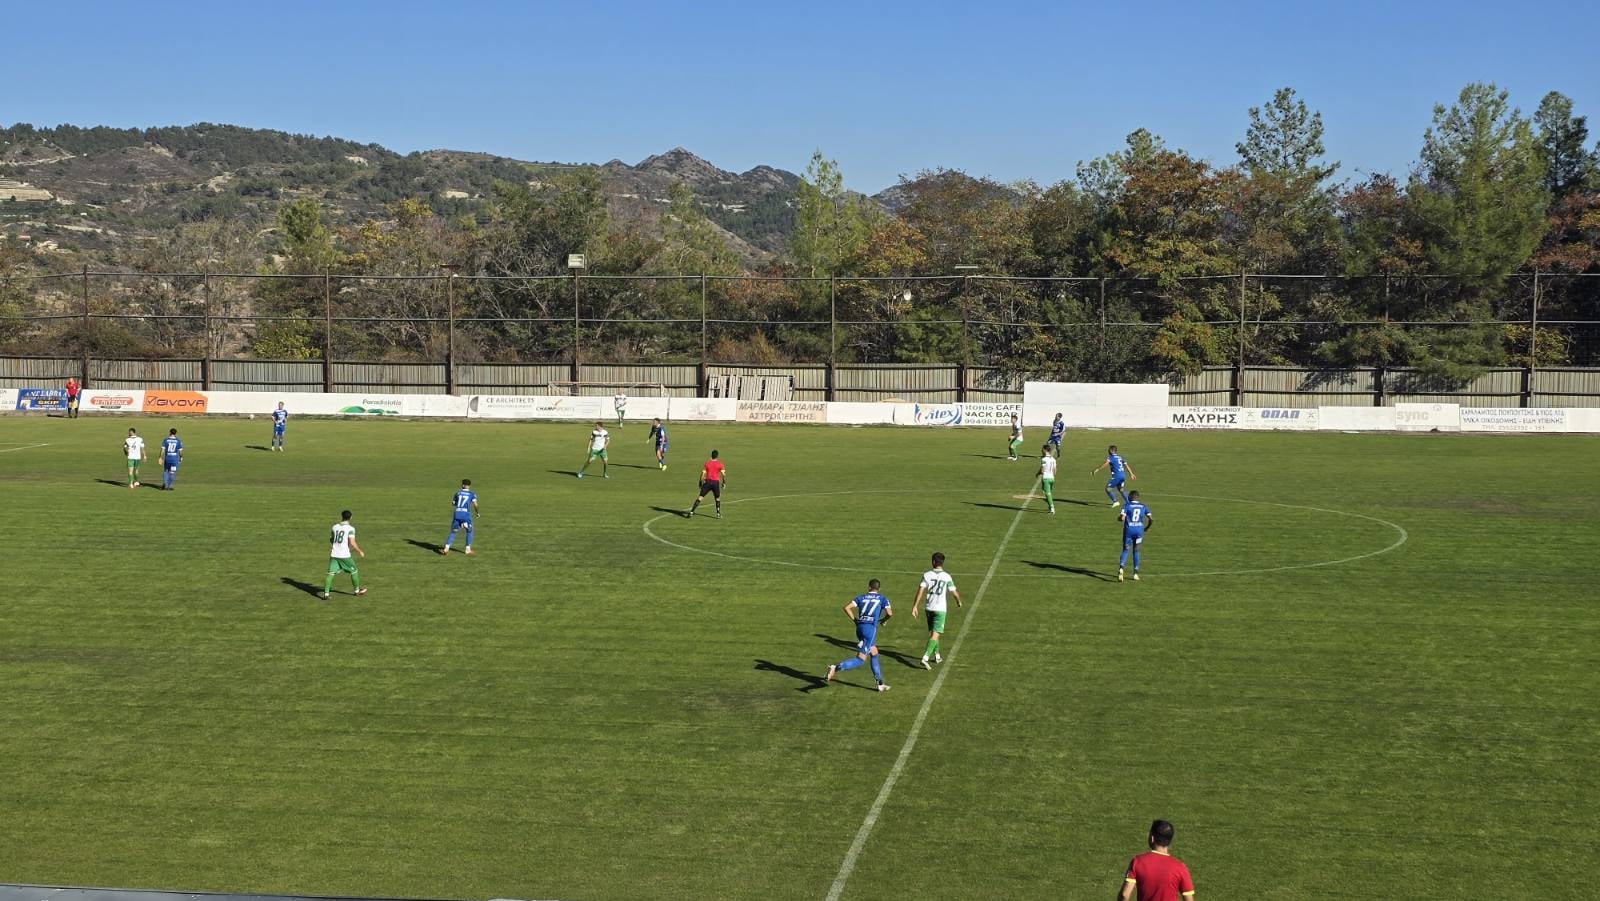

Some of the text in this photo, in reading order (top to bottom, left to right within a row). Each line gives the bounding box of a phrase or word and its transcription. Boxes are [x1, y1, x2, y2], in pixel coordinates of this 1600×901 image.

[156, 399, 205, 407] GIVOVA
[1172, 413, 1238, 424] ΜΑΥΡΗΣ
[1261, 410, 1300, 419] ΟΠΑΠ
[167, 442, 177, 453] 10
[457, 494, 470, 508] 17
[1132, 508, 1141, 522] 8
[334, 530, 345, 544] 18
[927, 578, 945, 596] 28
[859, 598, 881, 616] 77
